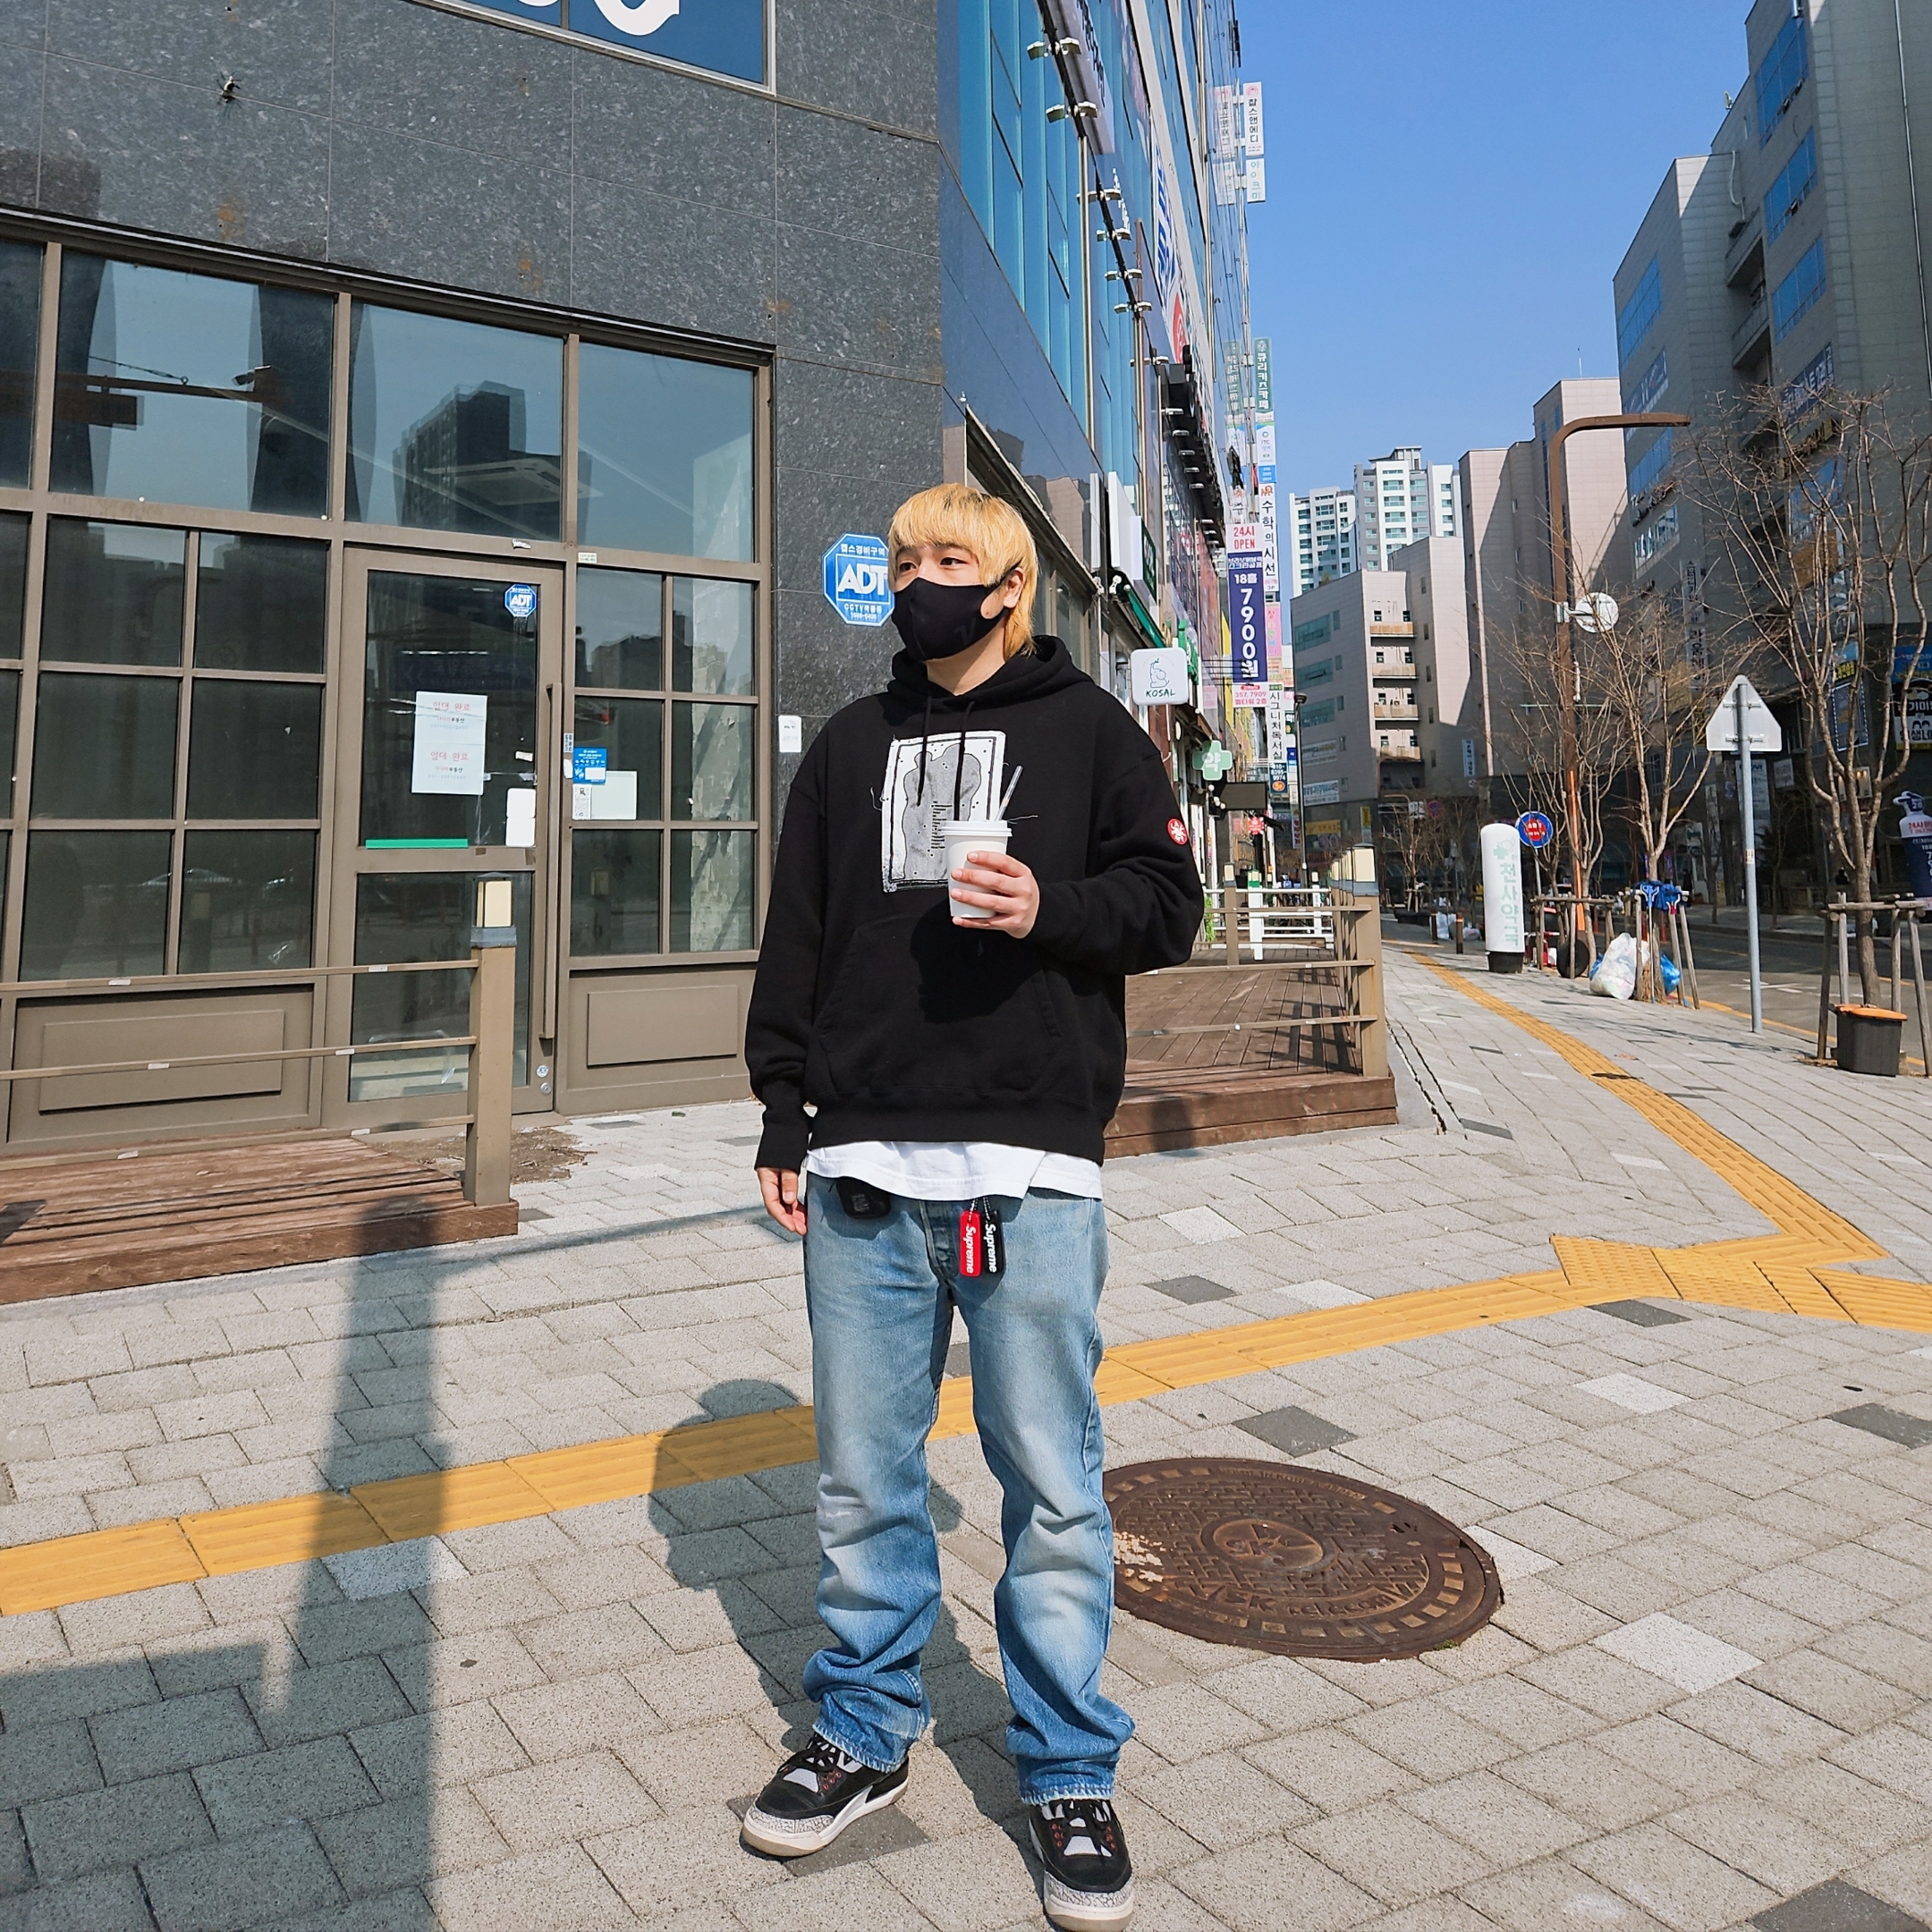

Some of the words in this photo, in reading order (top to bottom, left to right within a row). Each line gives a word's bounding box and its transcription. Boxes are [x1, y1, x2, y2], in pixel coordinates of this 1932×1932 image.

[1257, 352, 1269, 410] 큐리키즈카페
[1233, 525, 1255, 538] 24시
[1261, 500, 1276, 577] 수학의시선
[1233, 538, 1256, 550] OPEN
[837, 563, 888, 596] ADT
[1234, 572, 1258, 584] 18홀
[510, 594, 532, 607] ADT
[1146, 688, 1176, 699] KOSAL
[433, 701, 450, 711] 임대
[454, 703, 470, 712] 완료
[1269, 691, 1283, 760] 시그니처독서실
[430, 751, 447, 761] 임대
[453, 752, 469, 762] 완료
[1201, 752, 1221, 772] 약
[1500, 861, 1520, 946] 천사약국
[962, 1224, 976, 1274] Supreme
[983, 1223, 996, 1273] Supreme
[1224, 1590, 1277, 1613] SK
